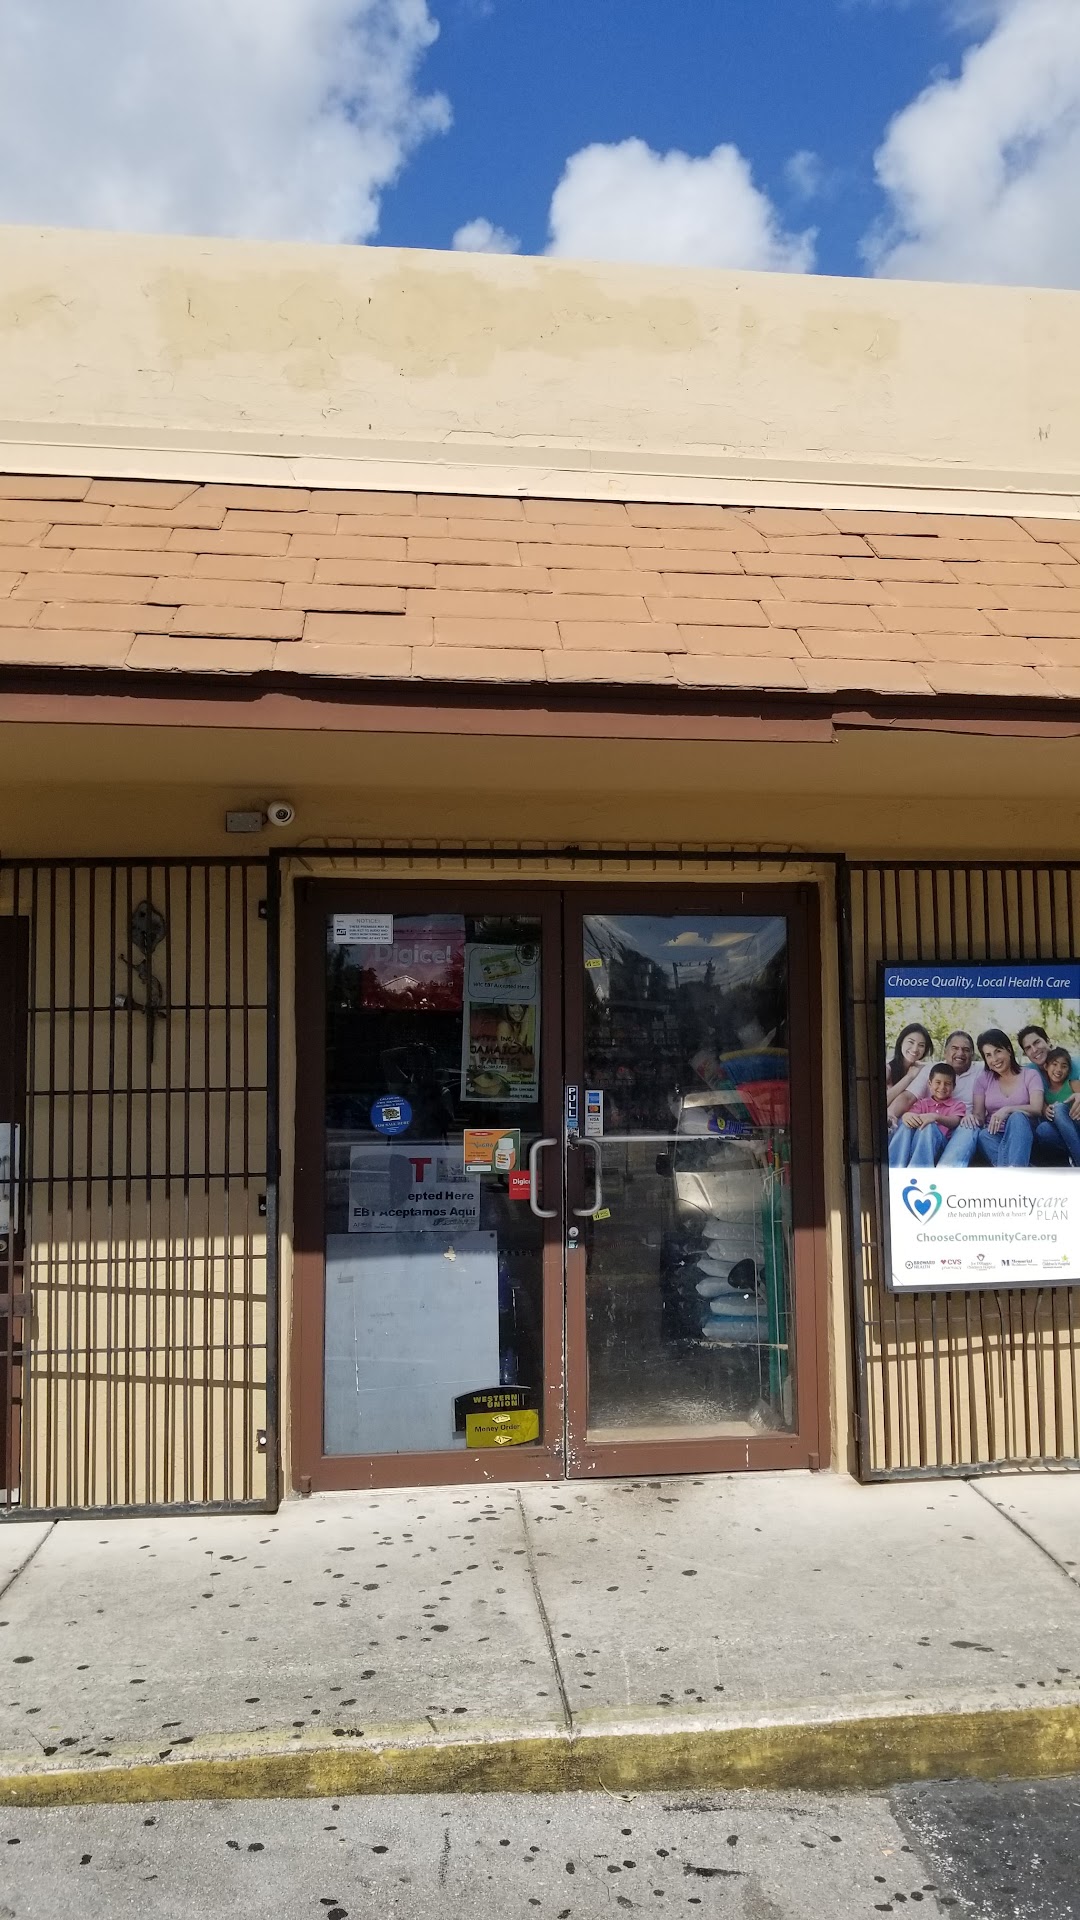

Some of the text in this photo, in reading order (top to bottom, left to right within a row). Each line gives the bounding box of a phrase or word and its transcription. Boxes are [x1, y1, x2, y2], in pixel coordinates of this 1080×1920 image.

[375, 943, 454, 967] Digicel
[888, 975, 1071, 990] Choose Quality, Local Health Care
[568, 1087, 576, 1117] PULL
[408, 1191, 474, 1202] epted Here
[977, 1211, 991, 1219] plan
[1036, 1210, 1069, 1221] PLAN
[916, 1231, 1057, 1243] ChooseCommunityCare.org
[473, 1393, 518, 1403] WESTERN
[486, 1400, 518, 1408] UNION
[474, 1423, 521, 1433] Money Order
